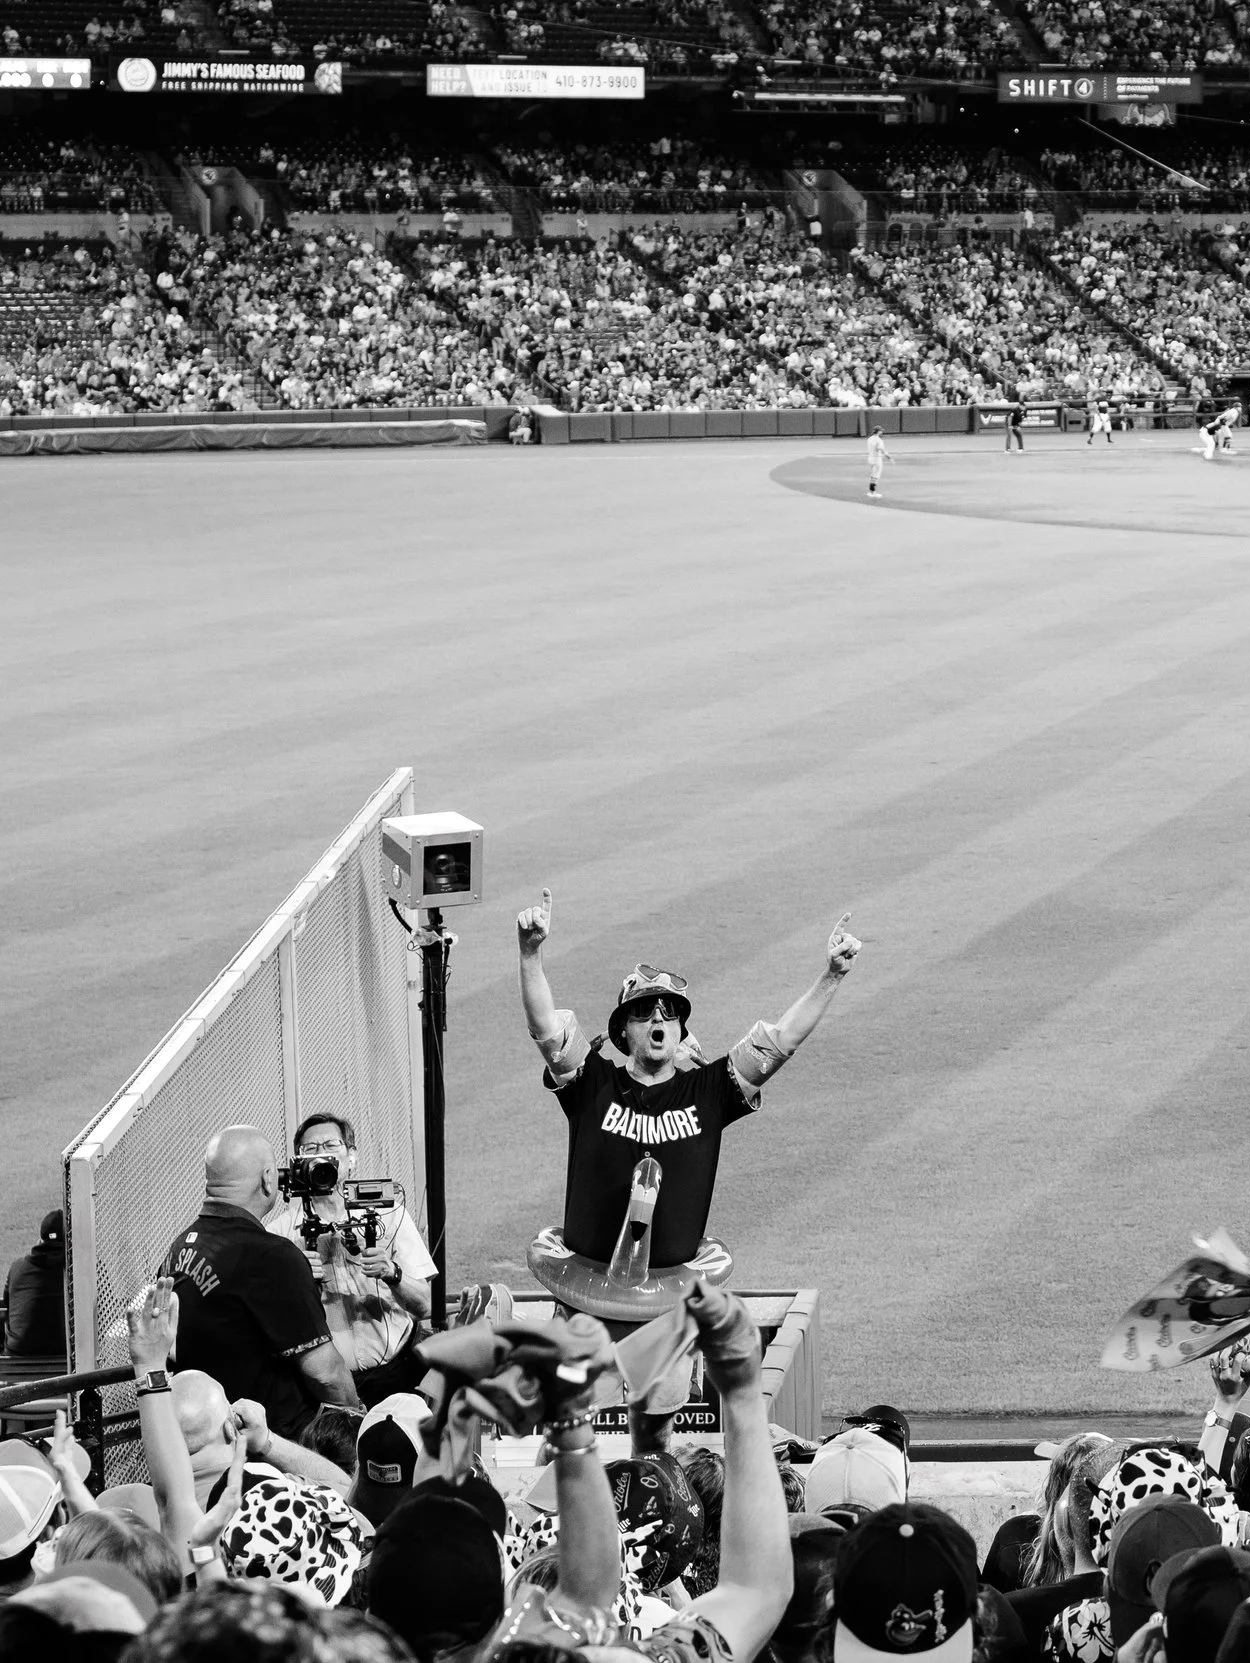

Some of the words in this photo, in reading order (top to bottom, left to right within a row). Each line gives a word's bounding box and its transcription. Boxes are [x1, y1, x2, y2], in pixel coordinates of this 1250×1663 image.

[162, 62, 209, 79] JIMMY'S
[210, 63, 254, 80] FAMOUS
[255, 64, 305, 81] SEAFOOD
[431, 66, 461, 80] NEED
[500, 69, 547, 80] LOCATION
[161, 81, 187, 91] FREE
[431, 80, 467, 92] HELP?
[504, 81, 532, 93] ISSUE
[555, 76, 637, 88] 410-873-9900
[601, 1101, 702, 1145] BALTIMORE
[175, 1247, 221, 1297] SPLASH
[673, 1412, 716, 1426] OVED
[617, 1517, 632, 1533] Lite
